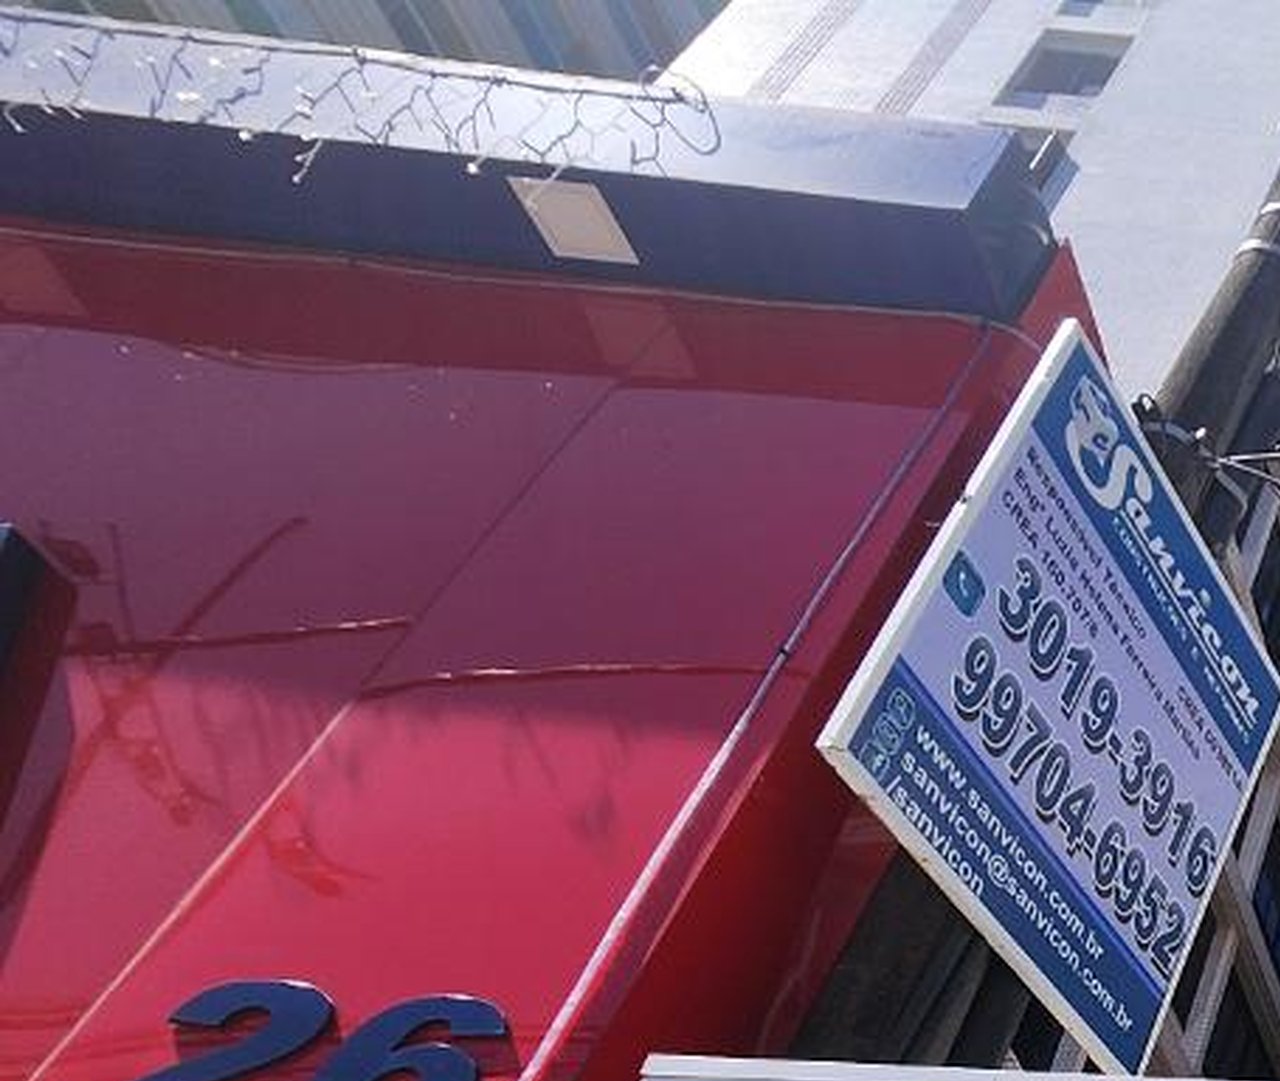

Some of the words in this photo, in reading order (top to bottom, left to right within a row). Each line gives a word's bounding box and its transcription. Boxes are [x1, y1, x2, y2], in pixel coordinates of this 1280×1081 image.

[1002, 489, 1040, 550] CREA
[1063, 425, 1259, 724] Sanvicon
[915, 723, 1105, 958] www.sanvicon.com.br
[952, 633, 1188, 979] 99704-6952
[998, 557, 1218, 900] 3019-3916
[899, 752, 1134, 1032] sanvicon@sanvicon.com.br
